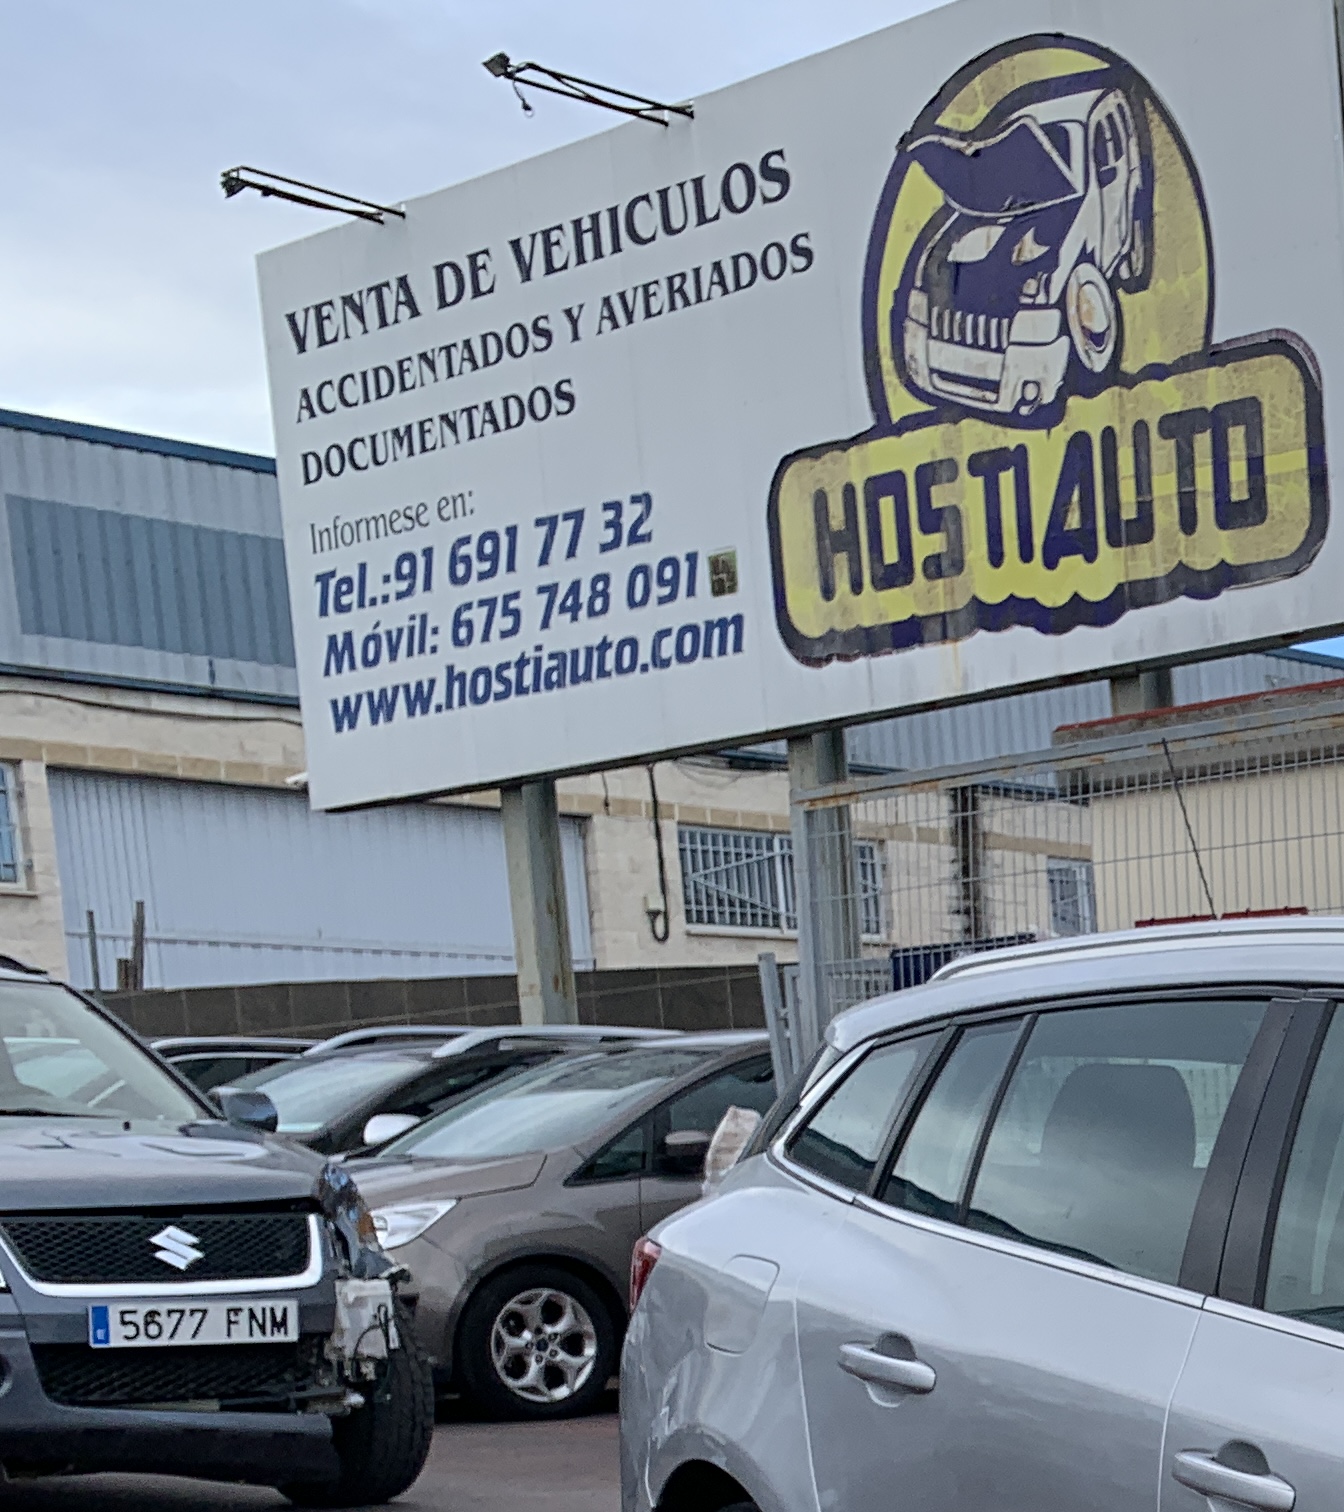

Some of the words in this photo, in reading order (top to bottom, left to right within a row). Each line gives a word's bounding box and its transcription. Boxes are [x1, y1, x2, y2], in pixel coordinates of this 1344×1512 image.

[284, 273, 422, 354] VENTA
[433, 248, 497, 311] DE
[508, 148, 791, 284] VEHICULOS
[296, 314, 553, 424] ACCIDENTADOS
[561, 303, 585, 343] Y
[595, 232, 815, 336] AVERIADOS
[300, 378, 576, 486] DOCUMENTADOS
[309, 502, 430, 554] Informese
[437, 490, 475, 522] en:
[449, 524, 518, 586] 691
[534, 508, 585, 568] 77
[599, 491, 653, 554] 32
[813, 396, 1268, 602] HOSTIAUTO
[323, 613, 439, 678] Móvil:
[452, 590, 521, 649] 675
[536, 572, 611, 631] 748
[626, 550, 699, 610] 091
[330, 613, 745, 734] www.hostiauto.com
[118, 1308, 209, 1341] 5677
[226, 1306, 289, 1338] FNM
